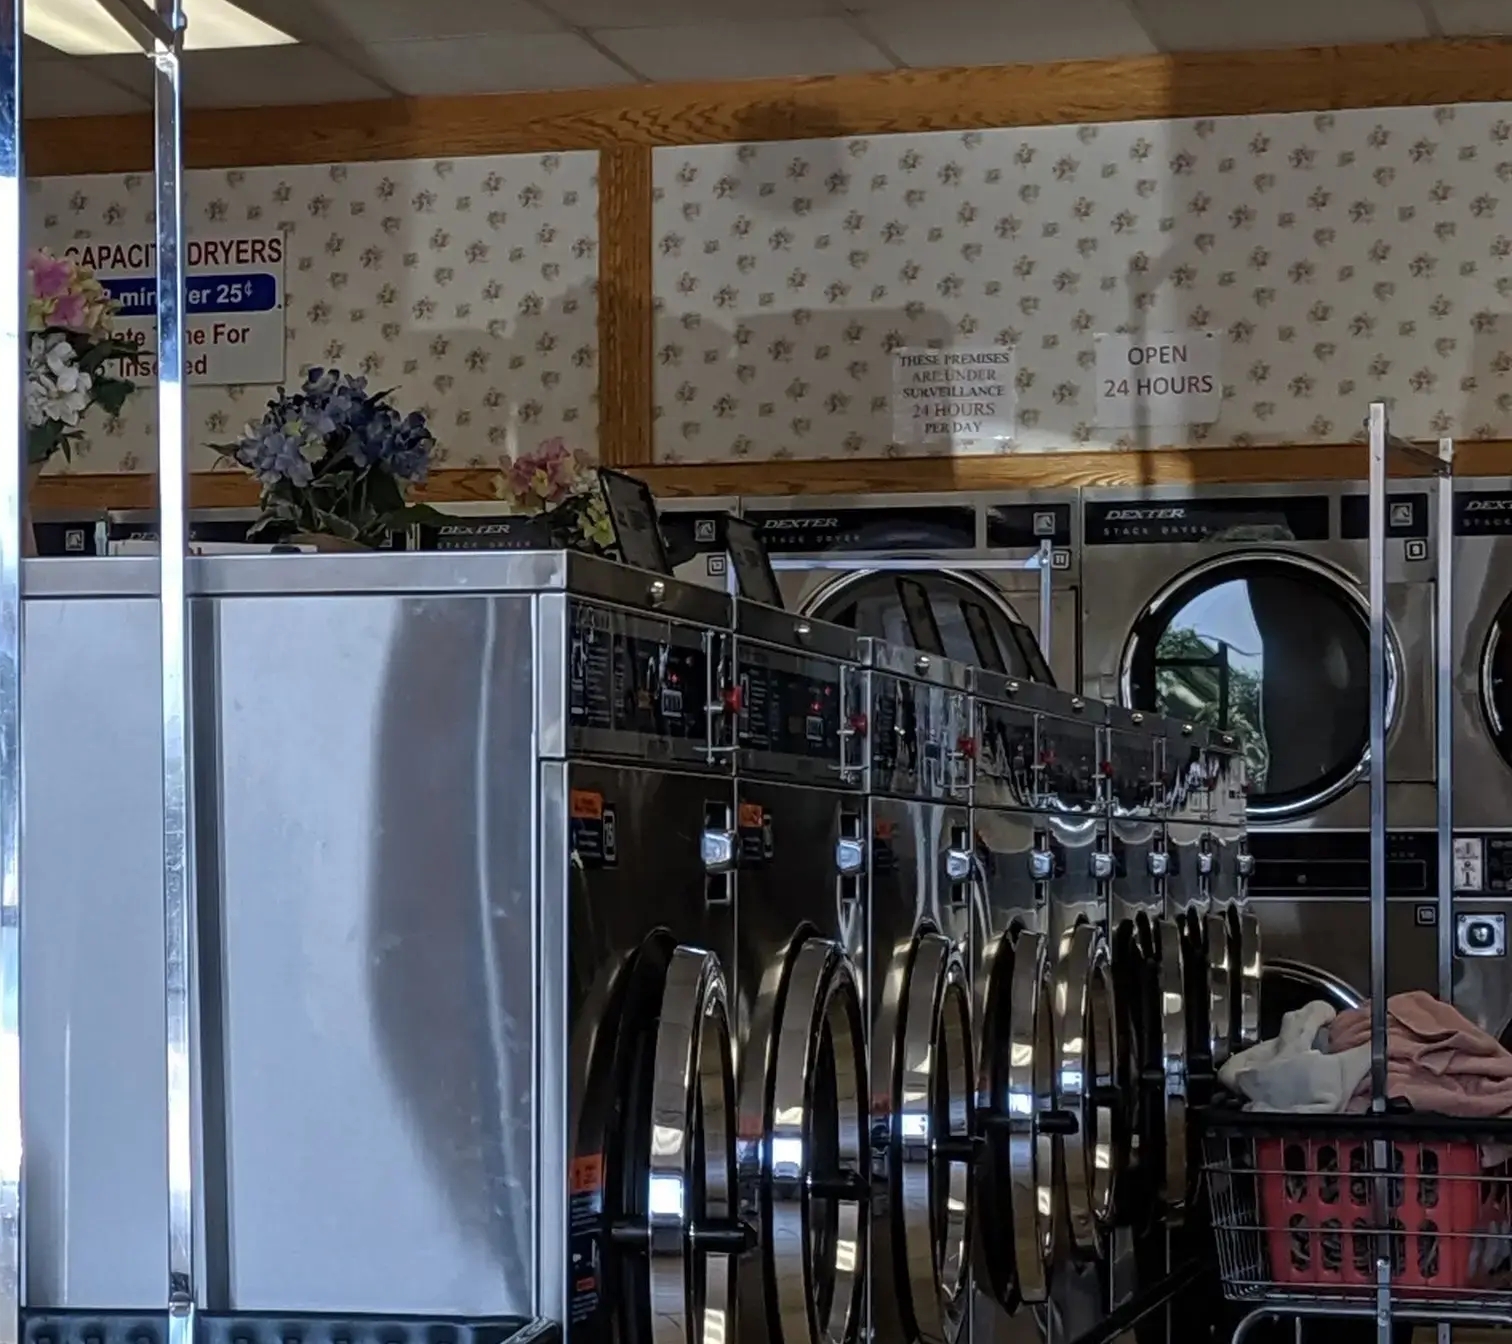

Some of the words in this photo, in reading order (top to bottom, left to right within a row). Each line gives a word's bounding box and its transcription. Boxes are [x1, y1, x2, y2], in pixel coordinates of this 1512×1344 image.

[65, 244, 157, 270] CAPACI
[188, 239, 282, 266] DRYERS
[185, 287, 212, 305] er
[216, 280, 254, 304] 25¢
[213, 323, 250, 345] For
[900, 354, 940, 367] THESE
[944, 353, 1010, 365] PREMISES
[1127, 344, 1188, 365] OPEN
[911, 371, 944, 382] ARE
[946, 369, 996, 381] UNDER
[903, 385, 1005, 398] SURVEILLANCE
[1104, 378, 1129, 397] 24
[1138, 374, 1213, 395] HOURS
[913, 404, 930, 418] 24
[934, 403, 996, 417] HOURS
[925, 422, 950, 433] PER
[953, 420, 983, 433] DAY
[1104, 508, 1187, 521] DEXTER
[438, 524, 511, 535] DEXTER
[763, 518, 839, 529] DEXTER
